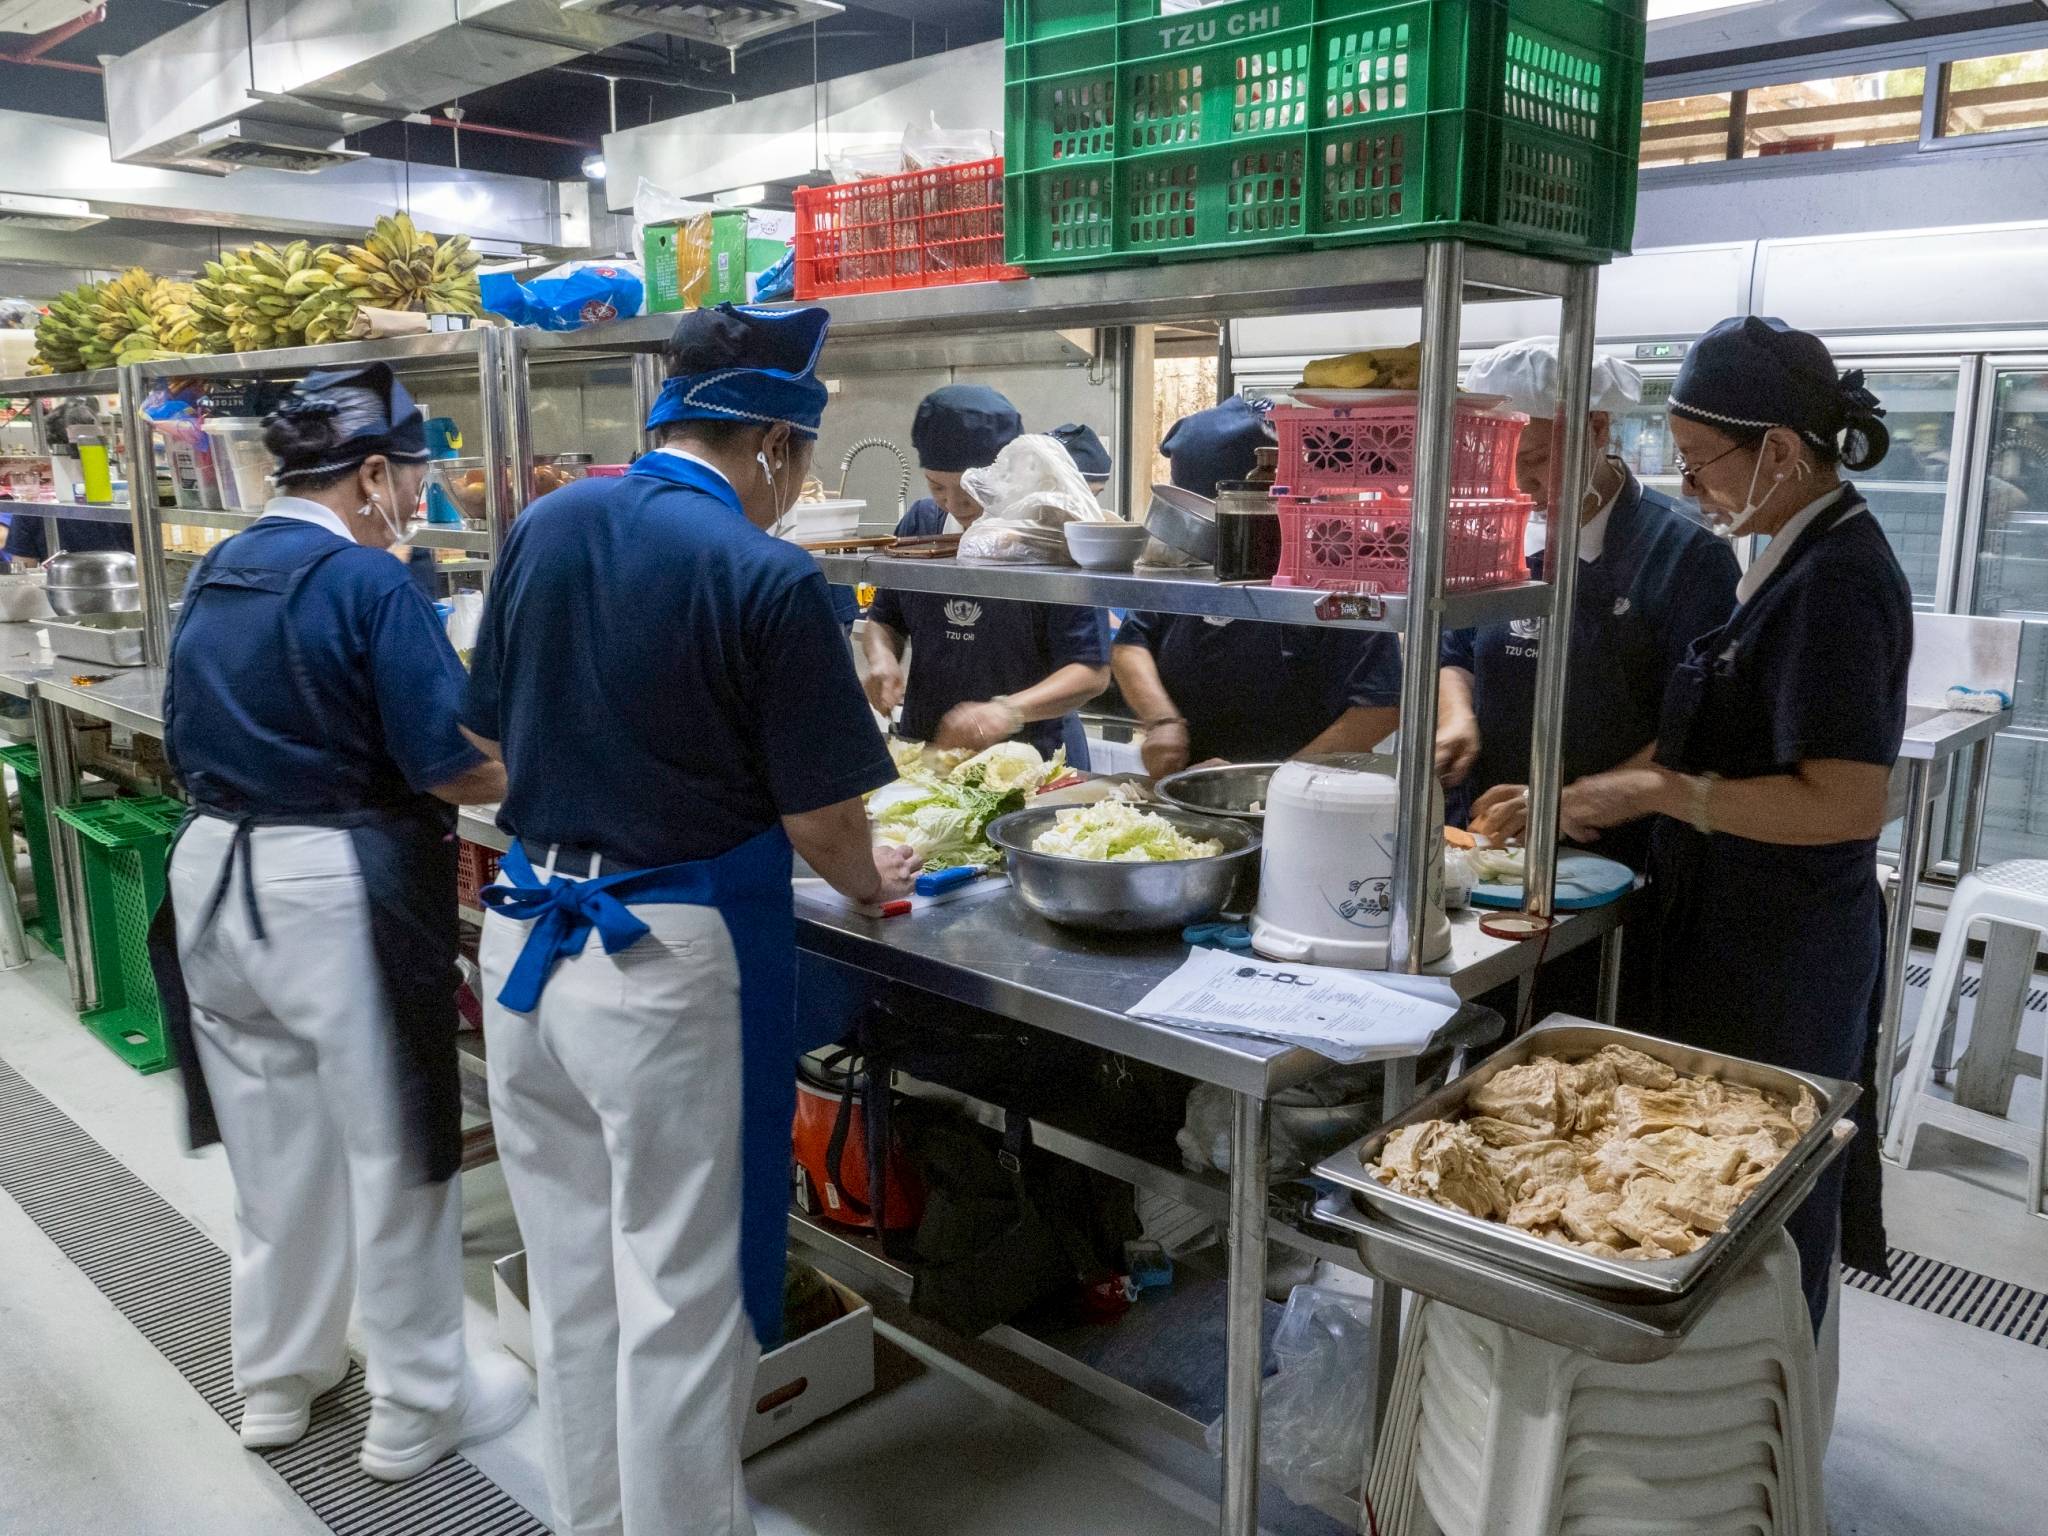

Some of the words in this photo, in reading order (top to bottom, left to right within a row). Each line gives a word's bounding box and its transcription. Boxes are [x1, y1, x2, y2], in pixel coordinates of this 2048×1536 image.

[1159, 20, 1216, 49] TZU
[1227, 6, 1280, 36] CHI
[945, 630, 961, 640] TZU
[962, 632, 975, 641] CHI
[1505, 645, 1522, 656] TZU
[1524, 647, 1539, 659] CH
